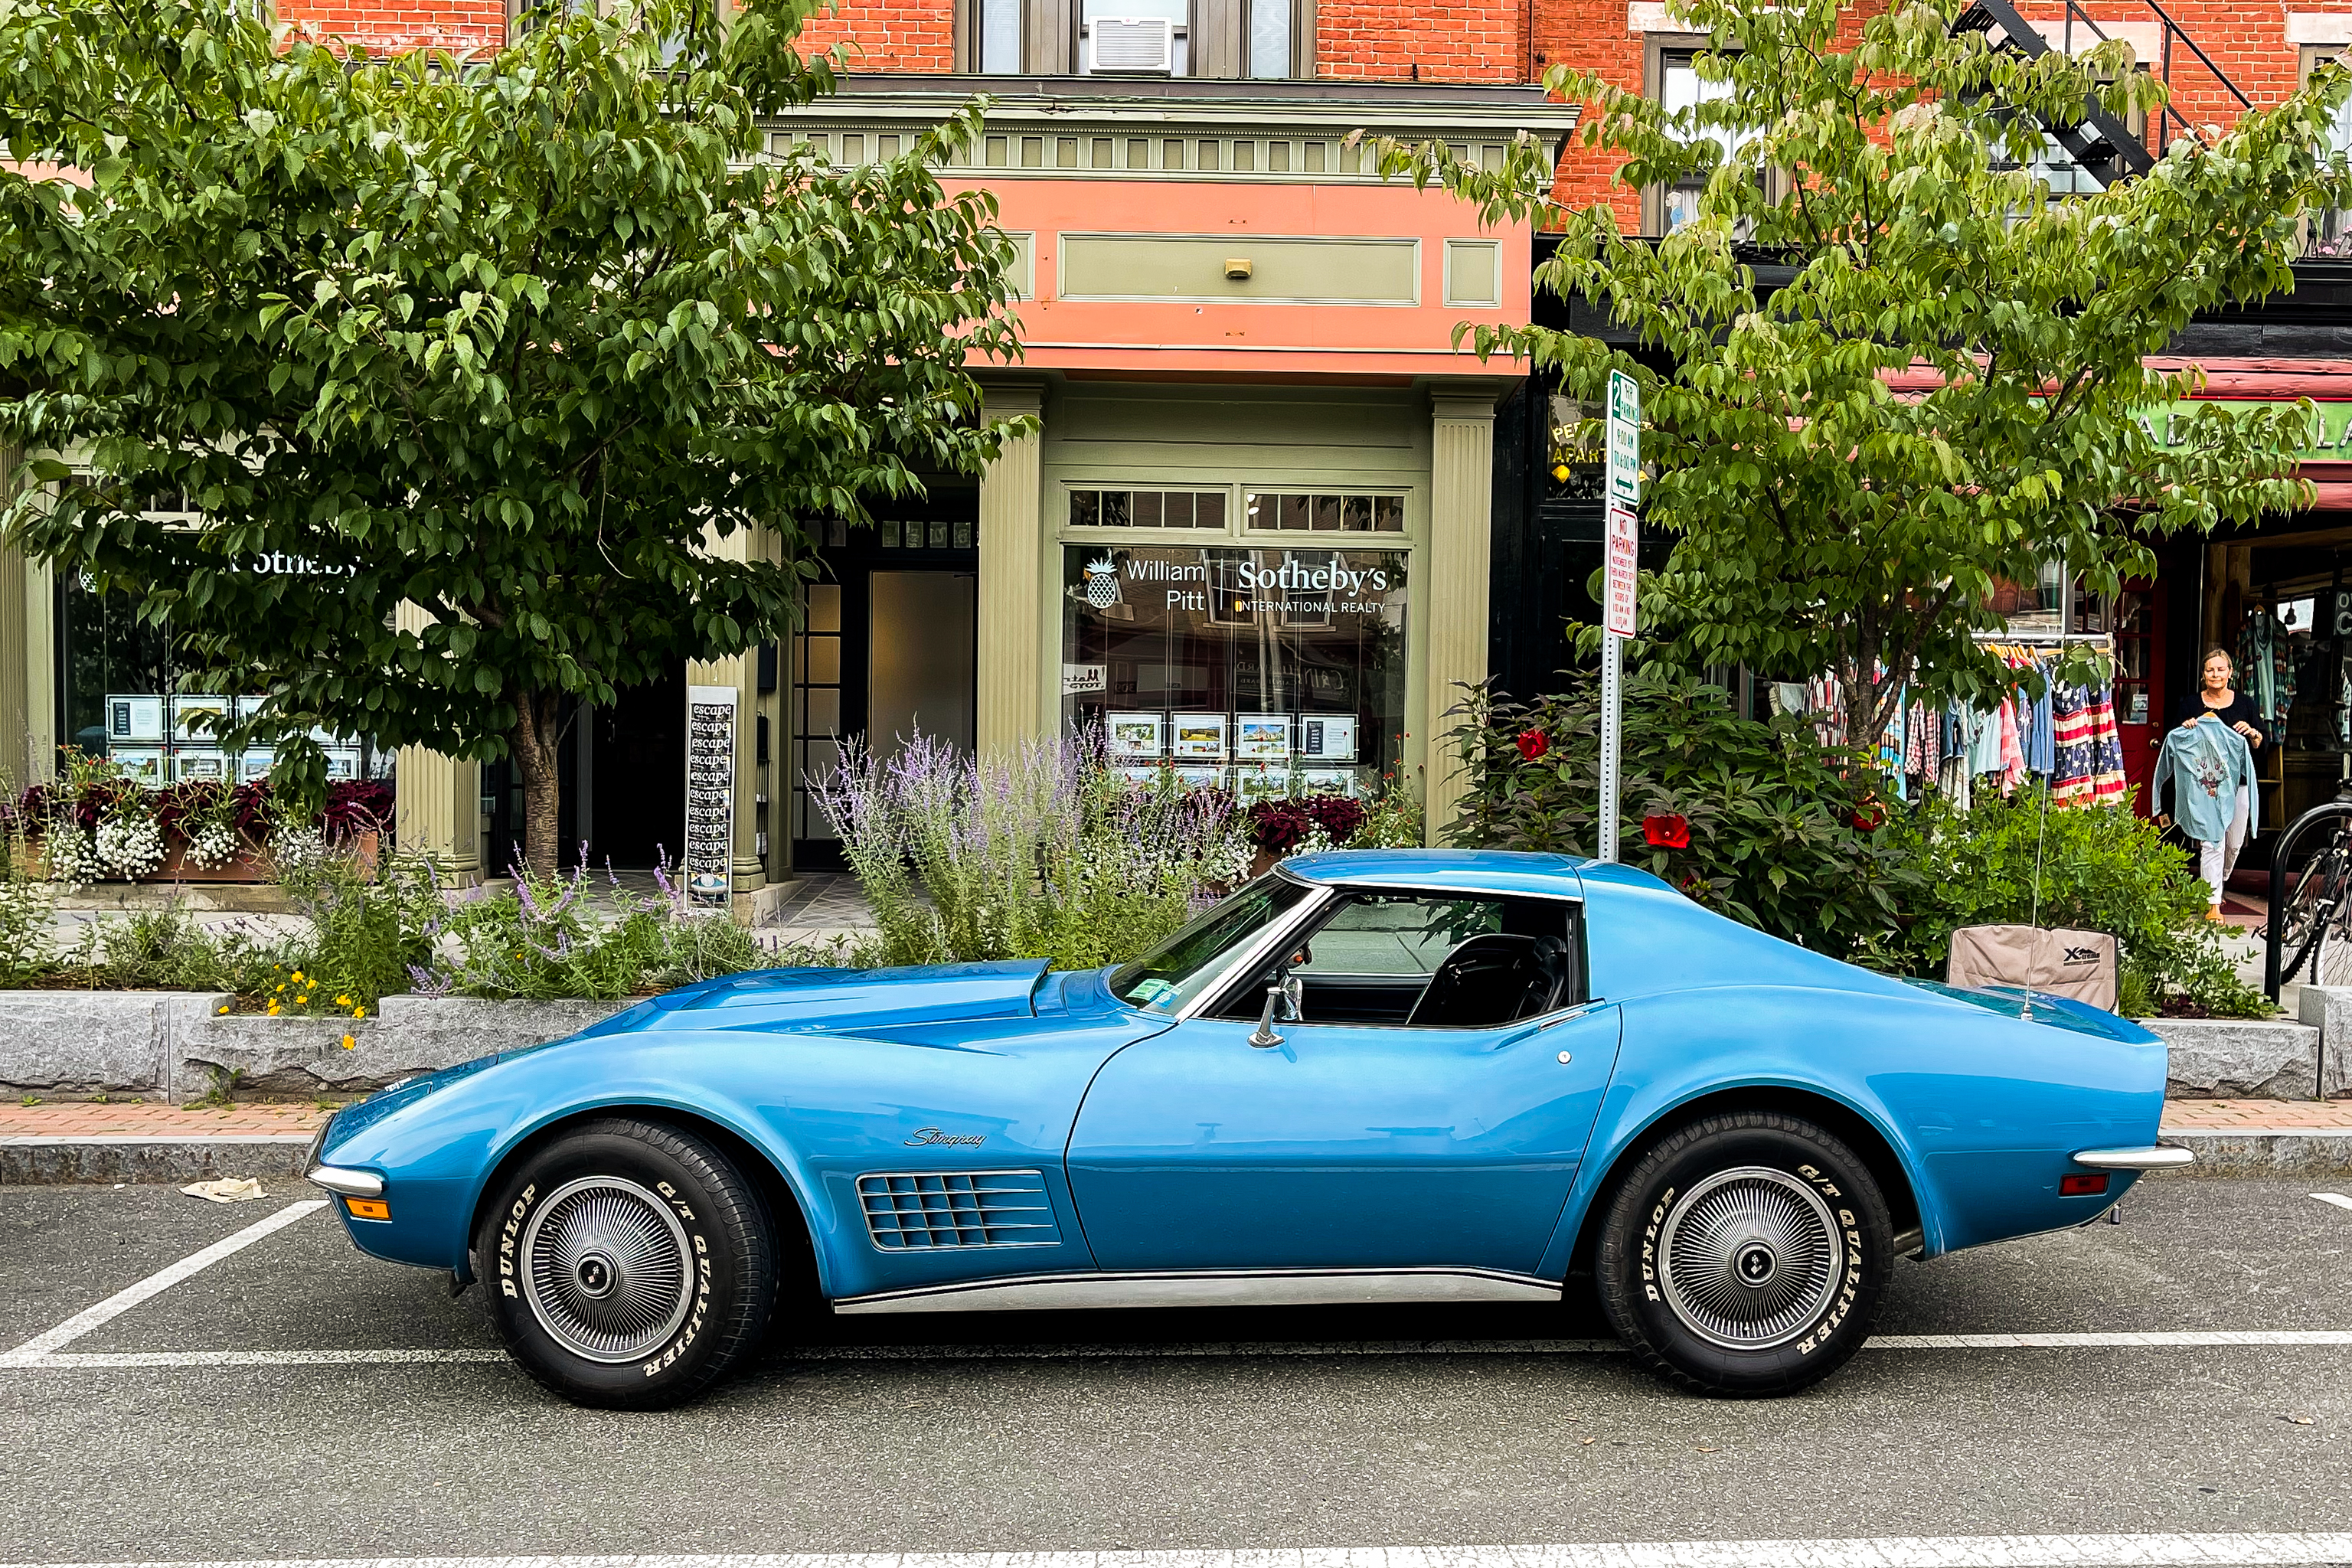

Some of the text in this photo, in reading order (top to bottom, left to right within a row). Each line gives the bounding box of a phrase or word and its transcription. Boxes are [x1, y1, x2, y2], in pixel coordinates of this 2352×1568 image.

[1613, 380, 1621, 413] 2
[1625, 382, 1633, 402] HR
[1619, 518, 1628, 535] NO
[1612, 534, 1635, 557] PARKING
[1125, 560, 1205, 582] William
[1237, 559, 1387, 597] Sotheby's
[1166, 590, 1205, 611] Pitt
[1237, 600, 1386, 613] INTERNATIONAL REALTY
[694, 704, 731, 718] escape
[691, 721, 728, 735] escape
[692, 738, 730, 751] escape
[690, 755, 727, 768] escape
[691, 772, 729, 785] escape
[690, 789, 726, 803] escape
[689, 806, 726, 820] escape
[689, 823, 727, 836] escape
[689, 841, 727, 854] escape
[689, 858, 727, 871] escape
[903, 1126, 988, 1148] Stingray
[1797, 1164, 1841, 1199] G/T
[657, 1181, 696, 1221] G/T
[500, 1183, 536, 1299] DUNLOP
[1642, 1187, 1675, 1302] DUNLOP
[1796, 1208, 1862, 1356] QUALIFIER
[642, 1234, 712, 1377] QUALIFIER
